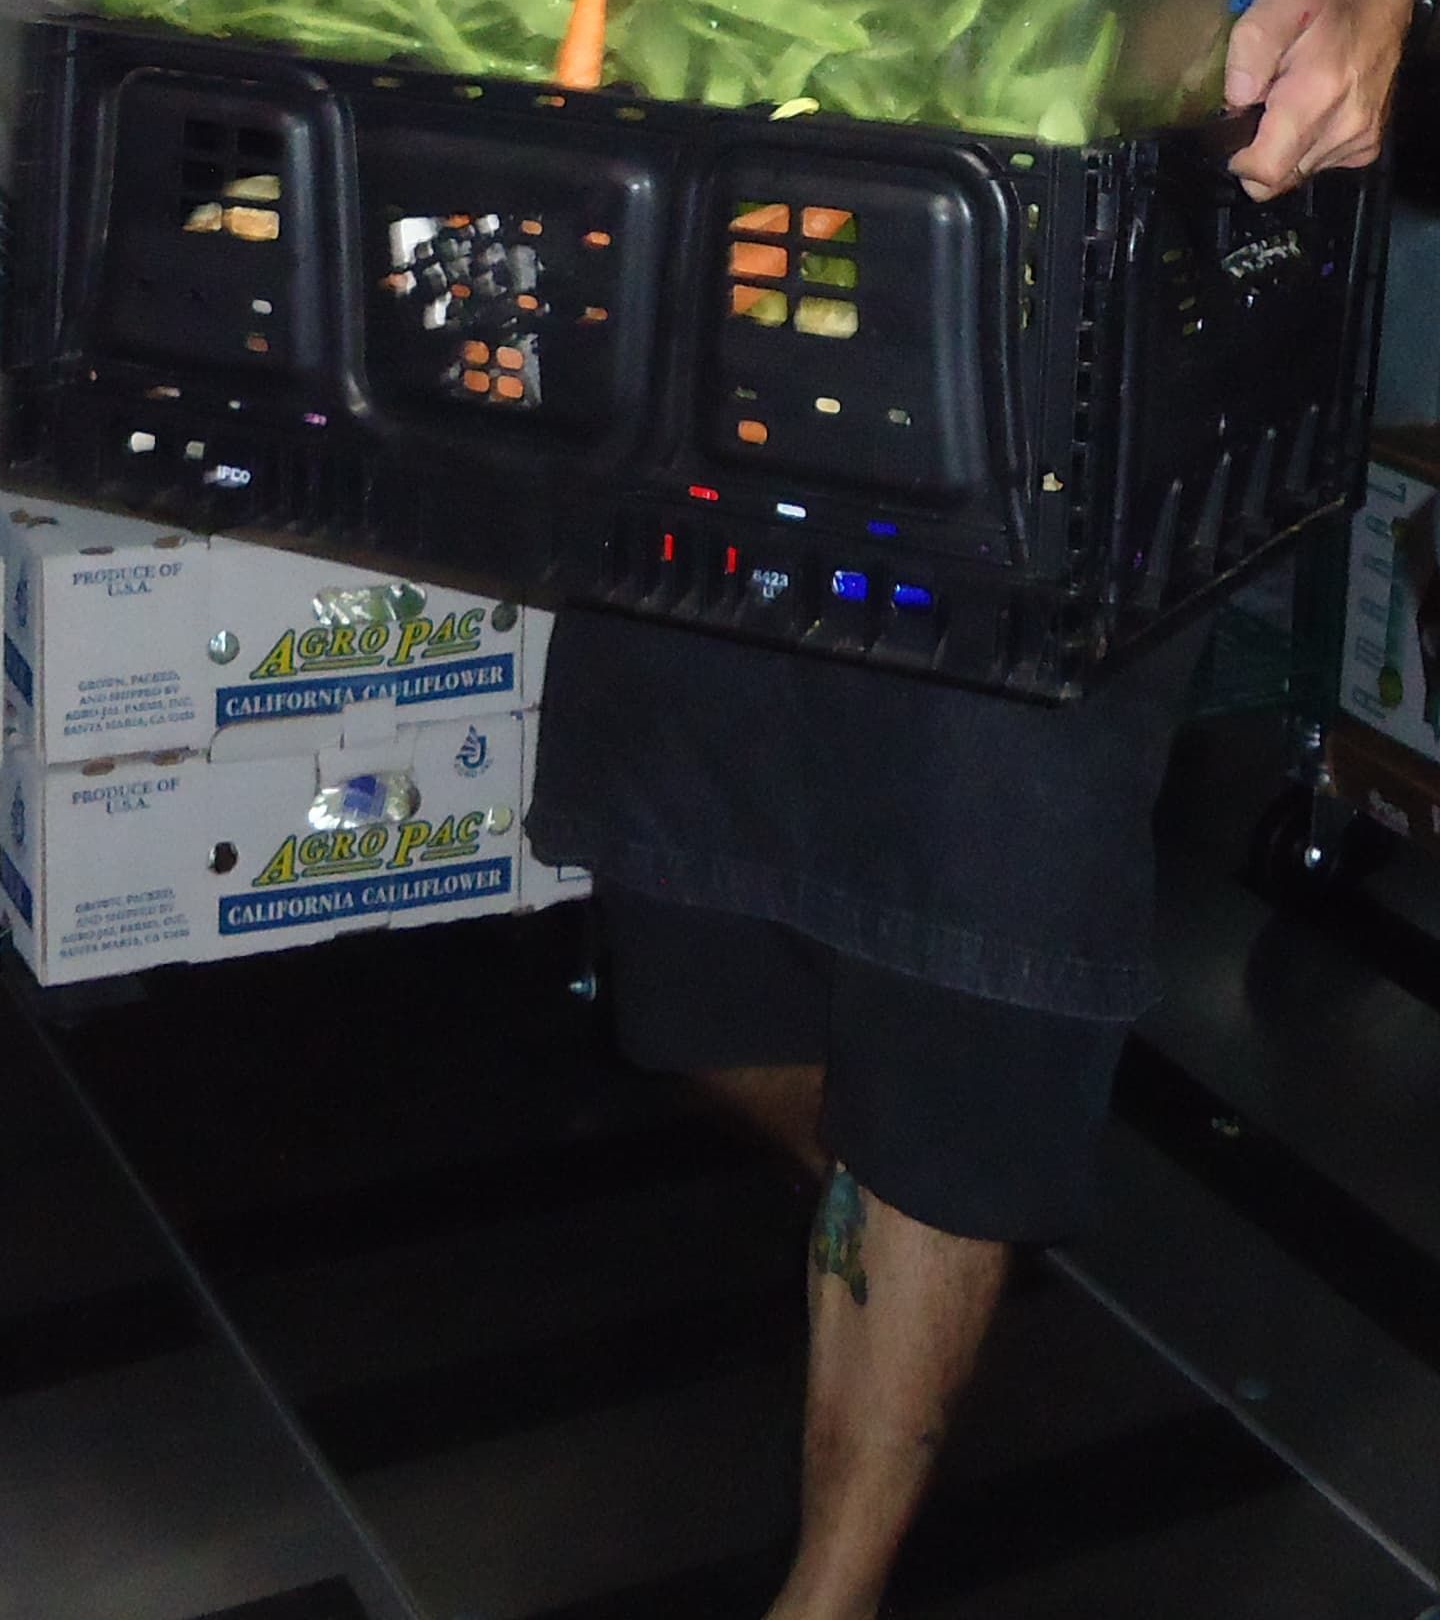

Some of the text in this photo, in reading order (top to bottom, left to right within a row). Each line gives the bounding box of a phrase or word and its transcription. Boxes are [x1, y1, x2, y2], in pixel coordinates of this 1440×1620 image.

[72, 562, 183, 586] PRODUCE OF
[249, 608, 486, 681] AGRO PAC
[225, 664, 504, 718] CALIFORNIA CAULIFLOWER
[71, 777, 180, 805] PRODUCE OF
[252, 811, 486, 887] AGRO PAC
[227, 868, 503, 926] CALIFORNIA CAULIFLOWER
